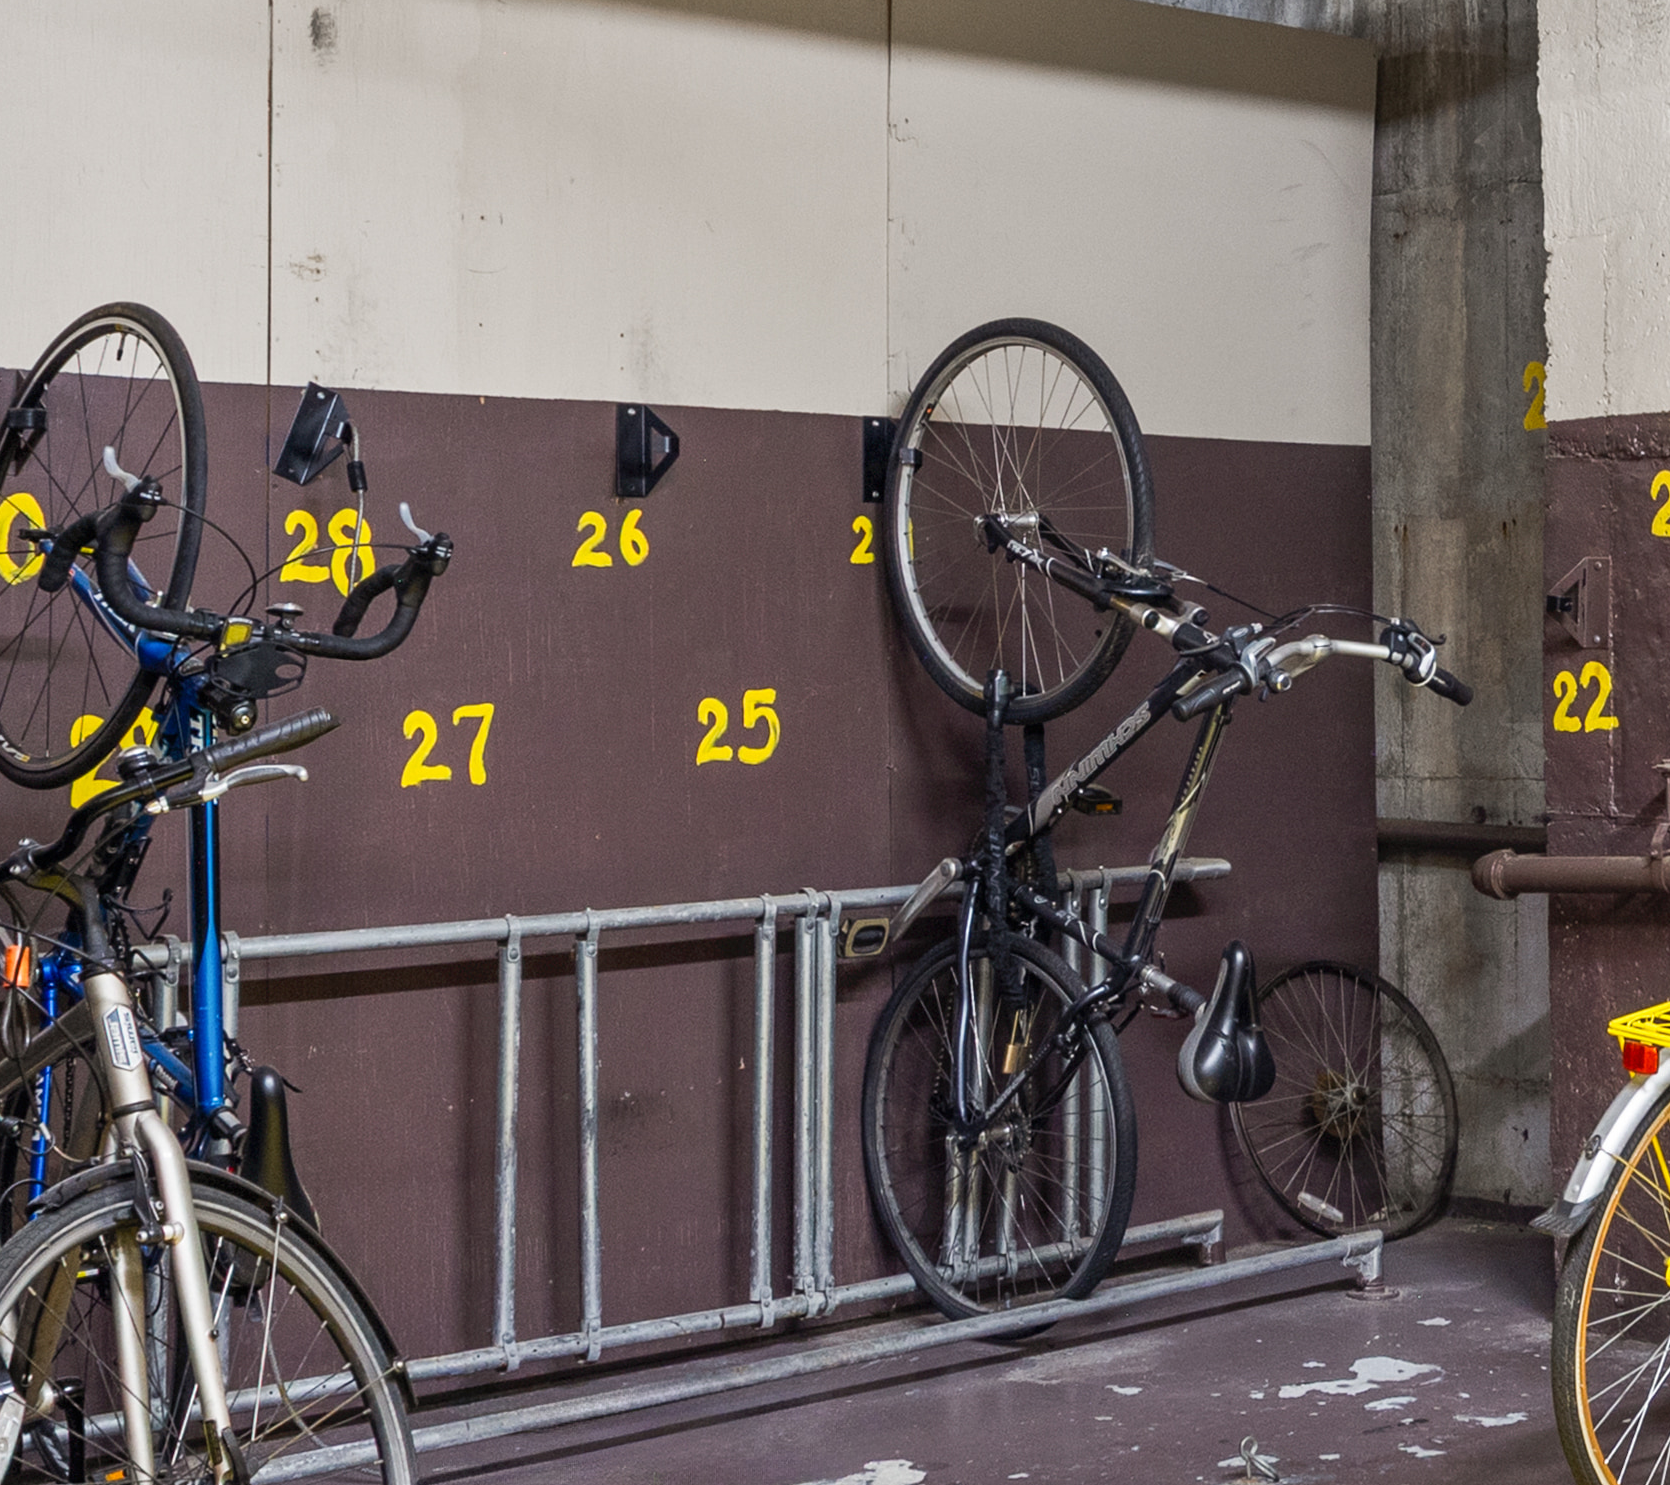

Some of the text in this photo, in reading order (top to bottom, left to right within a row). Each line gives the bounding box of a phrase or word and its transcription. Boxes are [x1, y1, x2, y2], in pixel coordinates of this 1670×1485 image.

[280, 509, 376, 599] 28
[571, 509, 651, 569] 26
[695, 688, 780, 766] 25
[1552, 660, 1620, 735] 22
[401, 702, 495, 788] 27
